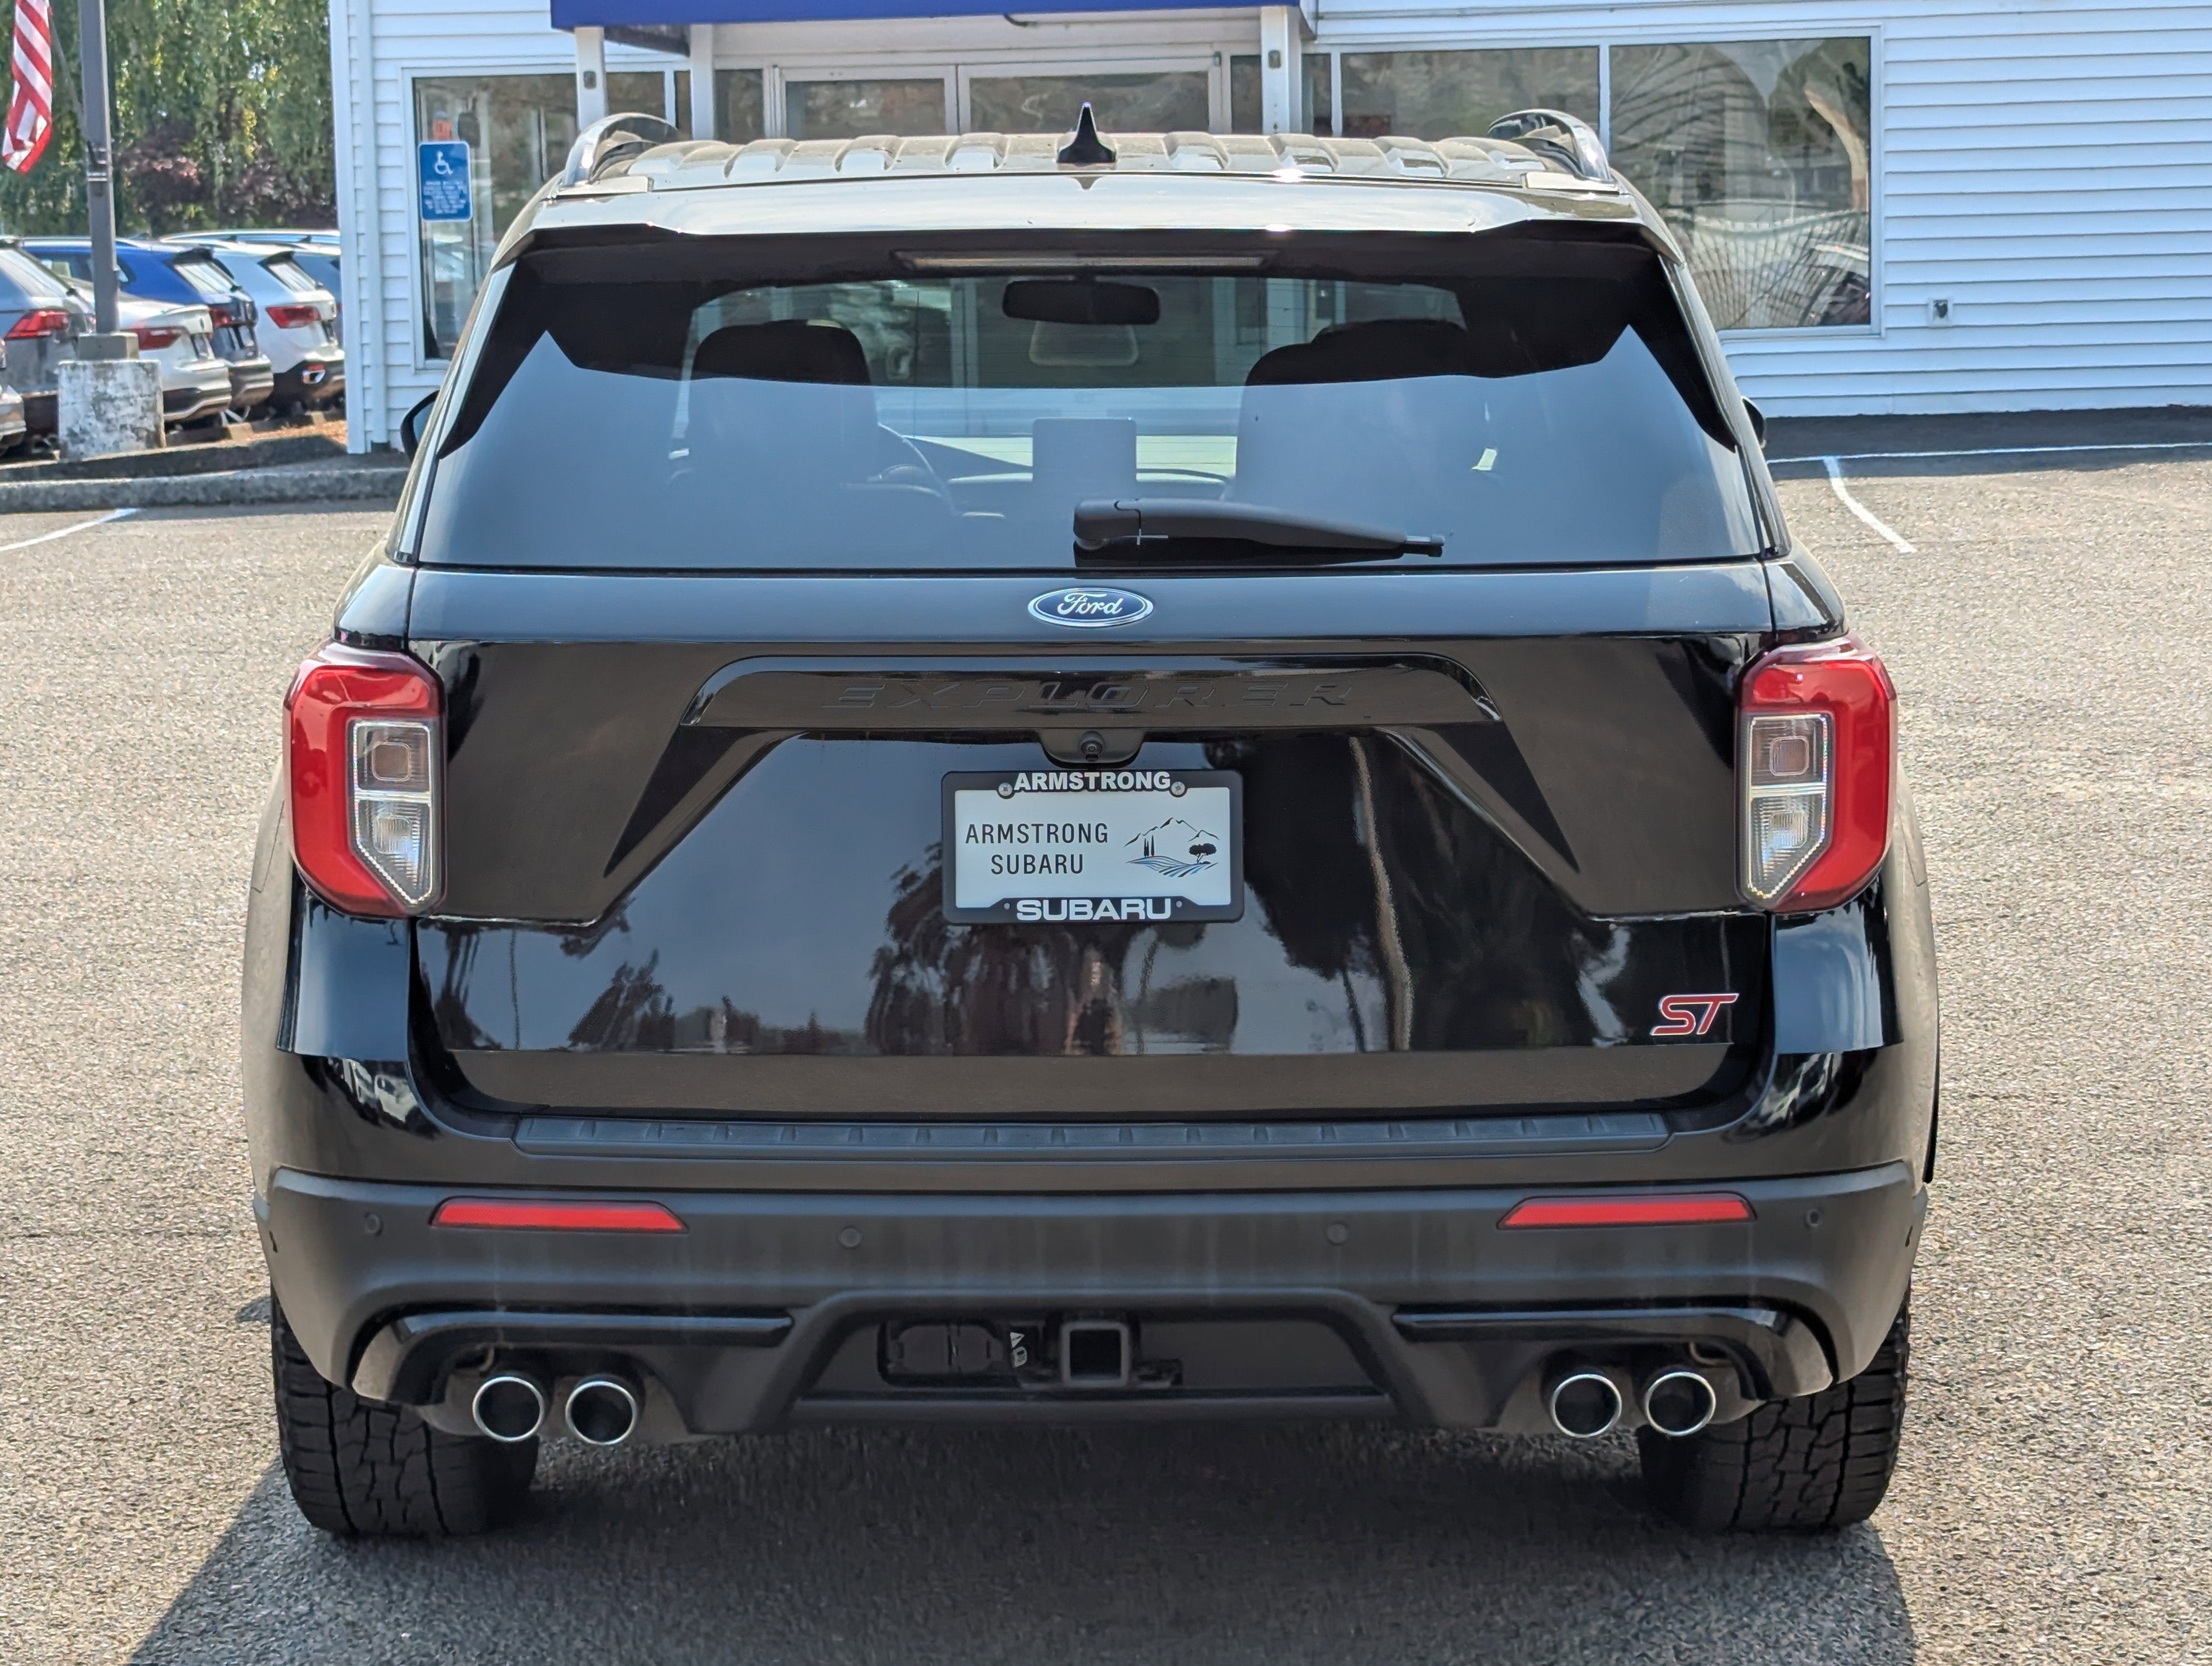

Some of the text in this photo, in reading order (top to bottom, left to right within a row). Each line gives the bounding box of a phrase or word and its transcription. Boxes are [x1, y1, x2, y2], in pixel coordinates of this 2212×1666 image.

[1057, 592, 1124, 615] Ford
[819, 680, 1352, 708] EXPLORER
[1013, 771, 1171, 791] ARMSTRONG
[965, 823, 1109, 844] ARMSTRONG
[991, 854, 1084, 875] SUBARU
[1016, 898, 1172, 921] SUBARU
[1650, 993, 1739, 1036] ST
